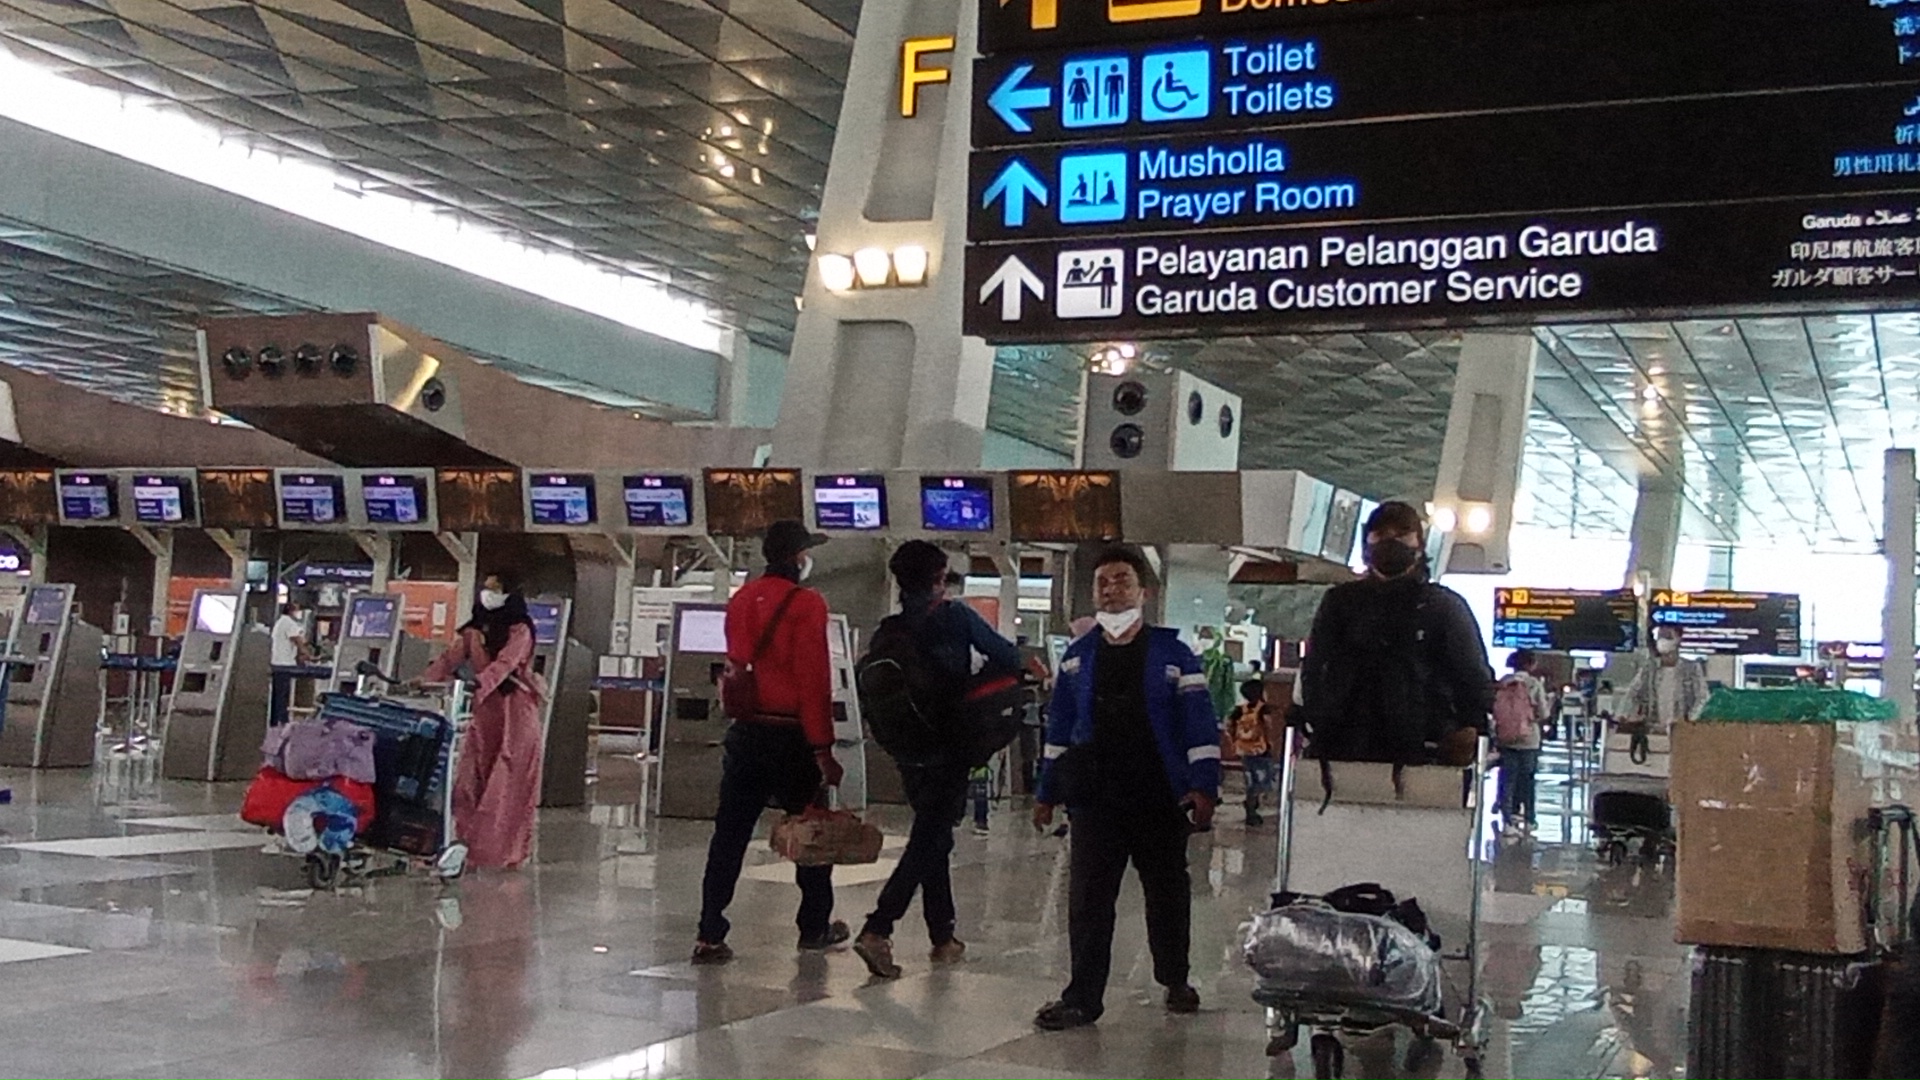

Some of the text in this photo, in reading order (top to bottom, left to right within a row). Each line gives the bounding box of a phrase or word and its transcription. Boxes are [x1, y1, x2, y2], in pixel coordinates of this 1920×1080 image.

[1893, 16, 1920, 37] 洗
[1223, 42, 1315, 76] Toilet
[902, 37, 954, 116] F
[1222, 82, 1333, 115] Toilets
[1894, 124, 1920, 145] 祈
[1138, 144, 1285, 180] Musholla
[1833, 152, 1920, 177] 男性用礼
[1138, 182, 1354, 223] Prayer Room
[1802, 213, 1862, 230] Garuda
[1136, 221, 1658, 281] Pelayanan Pelanggan Garuda
[1136, 267, 1582, 315] Garuda Customer Service
